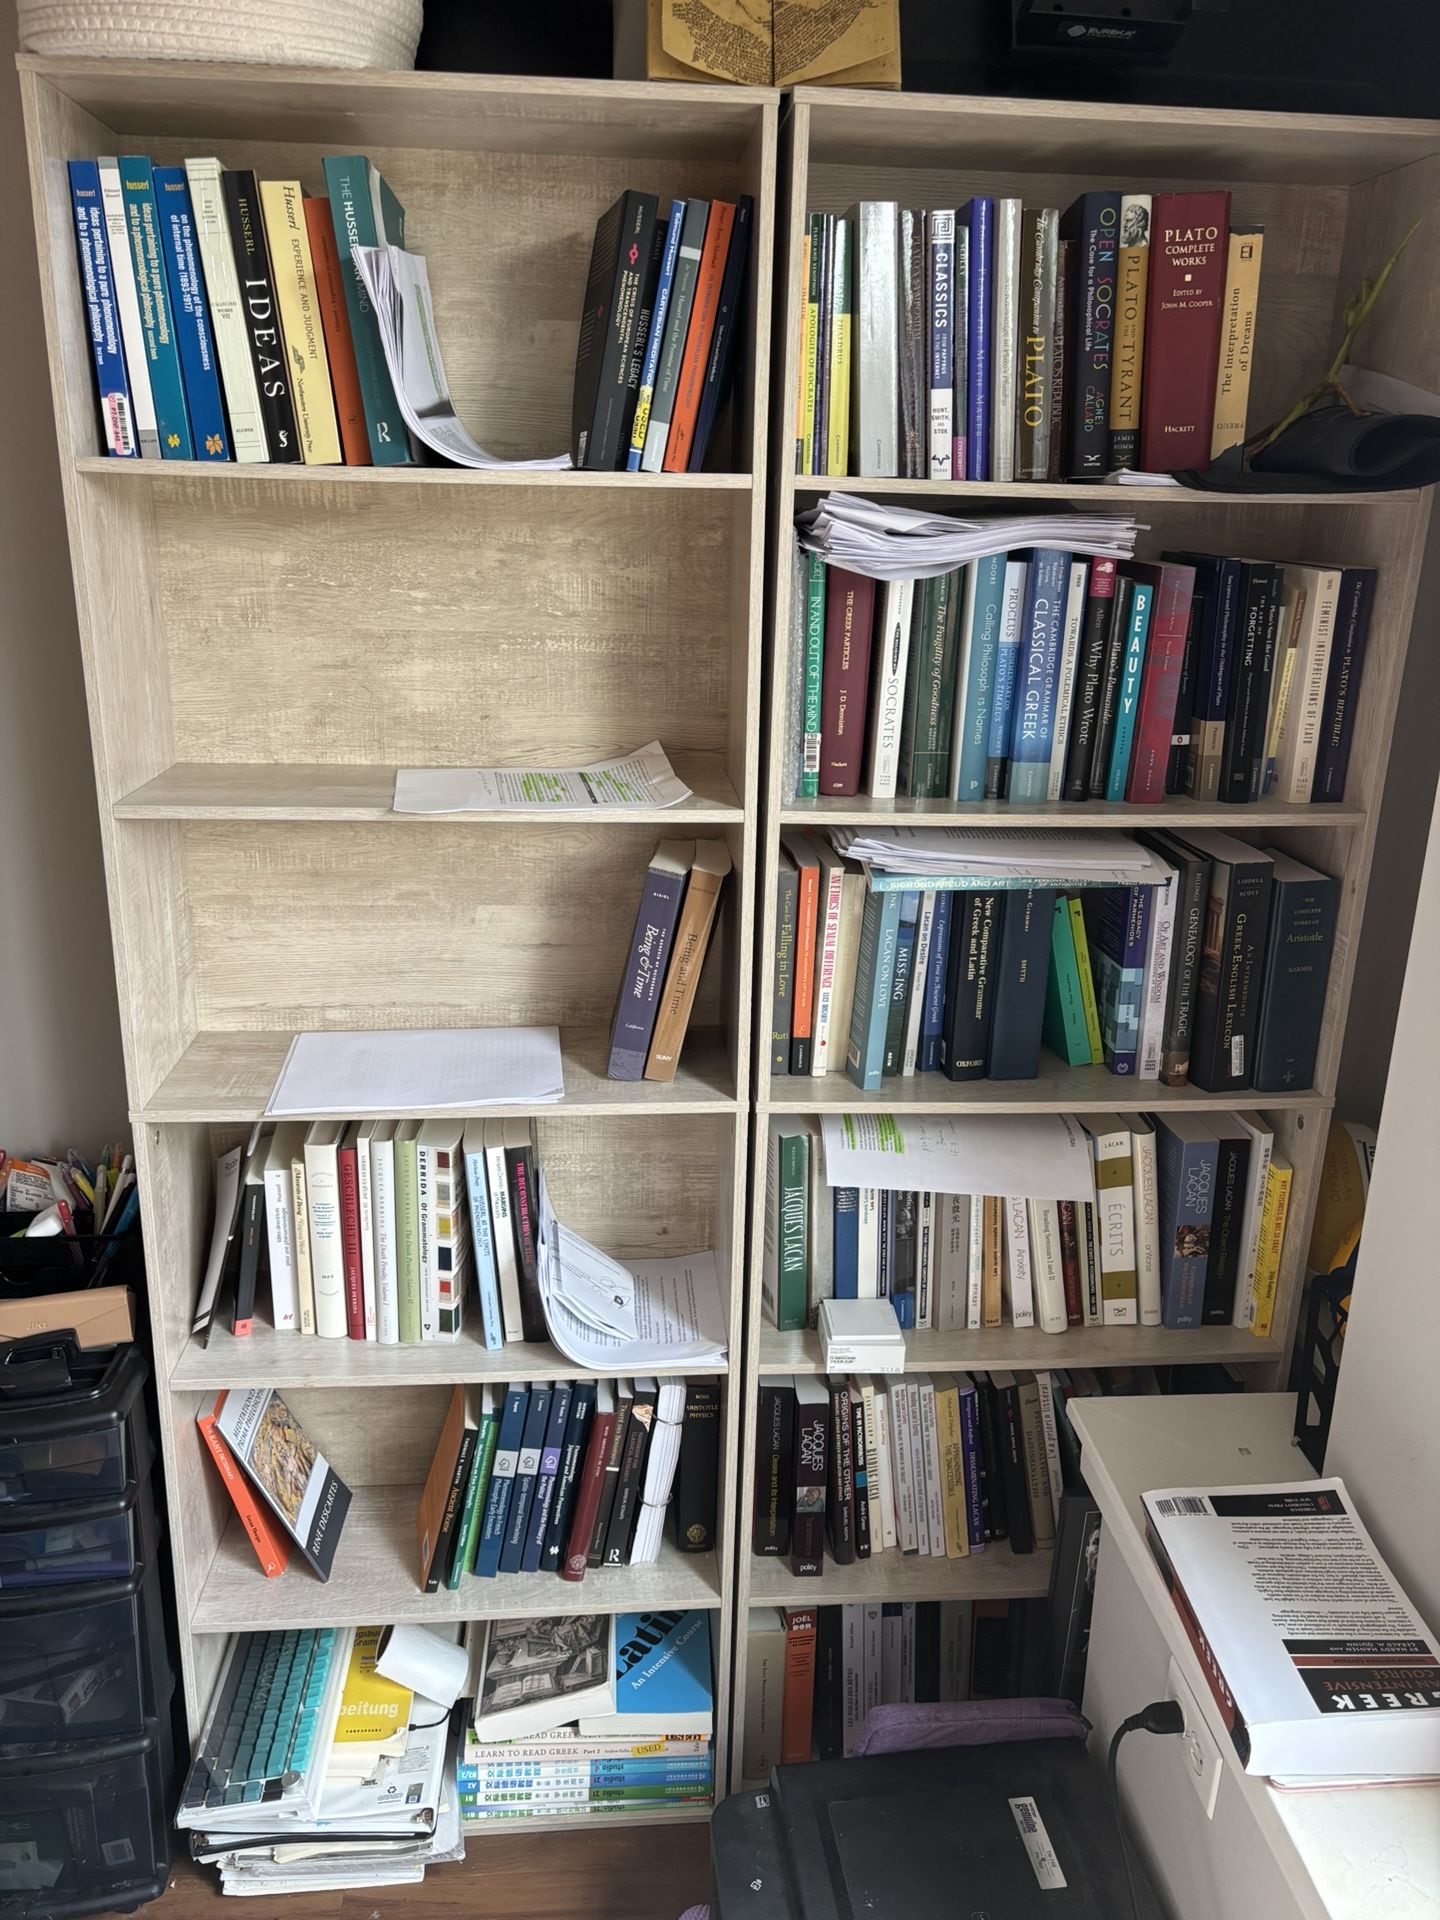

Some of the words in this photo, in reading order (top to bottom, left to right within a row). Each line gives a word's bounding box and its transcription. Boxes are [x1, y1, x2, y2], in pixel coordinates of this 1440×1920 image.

[181, 214, 188, 223] on
[283, 186, 300, 230] Husserl
[172, 223, 184, 252] internal
[182, 225, 191, 237] the
[238, 198, 255, 254] HUSSERL
[671, 213, 681, 244] Edmund
[1098, 207, 1117, 262] OPEN
[1165, 226, 1218, 243] PLATO
[177, 253, 186, 270] time
[292, 239, 306, 290] EXPERIENCE
[665, 246, 675, 275] Husserl
[1165, 243, 1215, 255] COMPLETE
[1172, 256, 1206, 267] WORKS
[183, 238, 198, 295] phenomenology
[179, 271, 194, 312] (1893-1917)
[193, 296, 200, 305] of
[300, 294, 310, 311] AND
[934, 252, 948, 328] CLASSICS
[1125, 255, 1140, 321] PLATO
[1173, 289, 1194, 297] EDITED
[195, 304, 203, 318] the
[1085, 286, 1095, 337] Philosophical
[1093, 277, 1113, 370] SOCRATES
[196, 319, 210, 371] consciousness
[246, 279, 285, 397] IDEAS
[304, 314, 317, 360] JUDGMENT
[634, 308, 650, 356] HUSSERL'S
[1085, 337, 1093, 351] Life
[1224, 288, 1240, 375] Interpretation
[1240, 311, 1253, 356] Dreams
[628, 358, 640, 389] LEGACY
[1240, 358, 1248, 372] of
[1024, 336, 1046, 428] PLATO
[1119, 341, 1136, 421] TYRANT
[1222, 378, 1232, 395] The
[1084, 386, 1095, 432] CALLARD
[1094, 392, 1105, 425] AGNES
[981, 604, 996, 640] Calling
[1006, 588, 1019, 638] PROCLUS
[1051, 600, 1060, 616] THE
[1096, 608, 1104, 629] Allen
[1028, 599, 1049, 685] CLASSICAL
[1047, 621, 1059, 674] CAMBRIDGE
[1244, 607, 1257, 666] FORGETTING
[1086, 641, 1103, 670] Why
[1124, 595, 1145, 714] BEAUTY
[977, 644, 993, 705] Philosophrs
[1085, 674, 1098, 704] Plato
[882, 678, 899, 748] SOCRATES
[1022, 690, 1040, 740] GREEK
[1040, 677, 1053, 725] GRAMMAR
[975, 709, 986, 745] Names
[1040, 728, 1048, 739] OF
[1079, 708, 1095, 744] Wrote
[975, 898, 981, 907] of
[985, 897, 994, 916] New
[973, 909, 981, 936] Greek
[1286, 933, 1323, 942] Aristotle
[679, 933, 698, 964] Being
[776, 924, 792, 961] Falling
[883, 929, 894, 963] LACAN
[919, 942, 928, 964] Desire
[980, 920, 993, 976] Comparative
[1228, 913, 1247, 1001] GREEK-ENGLISH
[676, 964, 689, 986] and
[780, 963, 788, 972] in
[880, 966, 889, 982] ON
[968, 955, 977, 981] Latin
[778, 974, 790, 997] Love
[877, 984, 888, 1009] LOVE
[976, 977, 986, 1020] Grammar
[670, 987, 686, 1016] Time
[1224, 1003, 1237, 1050] LEXICON
[655, 1053, 672, 1062] SUNY
[1104, 1140, 1123, 1149] LACAN
[343, 1164, 356, 1239] GESCHLECHT
[1185, 1167, 1199, 1207] LACAN
[1196, 1159, 1212, 1214] JACQUES
[421, 1202, 428, 1212] Of
[500, 1191, 508, 1218] MARGINS
[781, 1187, 803, 1239] JACQUES
[1012, 1203, 1024, 1239] LACAN
[1108, 1204, 1126, 1256] ÉCRITS
[348, 1241, 357, 1255] III
[421, 1214, 429, 1265] Grammatology
[784, 1240, 803, 1272] LACAN
[1016, 1249, 1026, 1280] Anxiety
[1015, 1311, 1032, 1319] polity
[233, 1389, 258, 1440] MEDITATIONES
[840, 1391, 848, 1430] ORIGINS
[208, 1432, 222, 1454] KANT
[461, 1437, 470, 1458] THOMAS
[801, 1428, 812, 1464] LACAN
[812, 1420, 824, 1472] JACQUES
[843, 1431, 849, 1443] OF
[454, 1465, 463, 1485] MARTIN
[867, 1448, 878, 1478] READING
[969, 1452, 980, 1502] DISSEMINATING
[844, 1466, 853, 1500] OTHER
[318, 1479, 339, 1528] DESCARTES
[448, 1486, 460, 1514] Ancient
[441, 1514, 452, 1533] Rome
[792, 1616, 812, 1624] JOËL
[631, 1678, 646, 1690] An
[642, 1646, 678, 1679] Intensive
[676, 1619, 704, 1645] Course
[1371, 1670, 1434, 1680] COURSE
[637, 1744, 661, 1753] USED
[602, 1789, 624, 1798] studio
[1015, 1803, 1037, 1833] genuine
